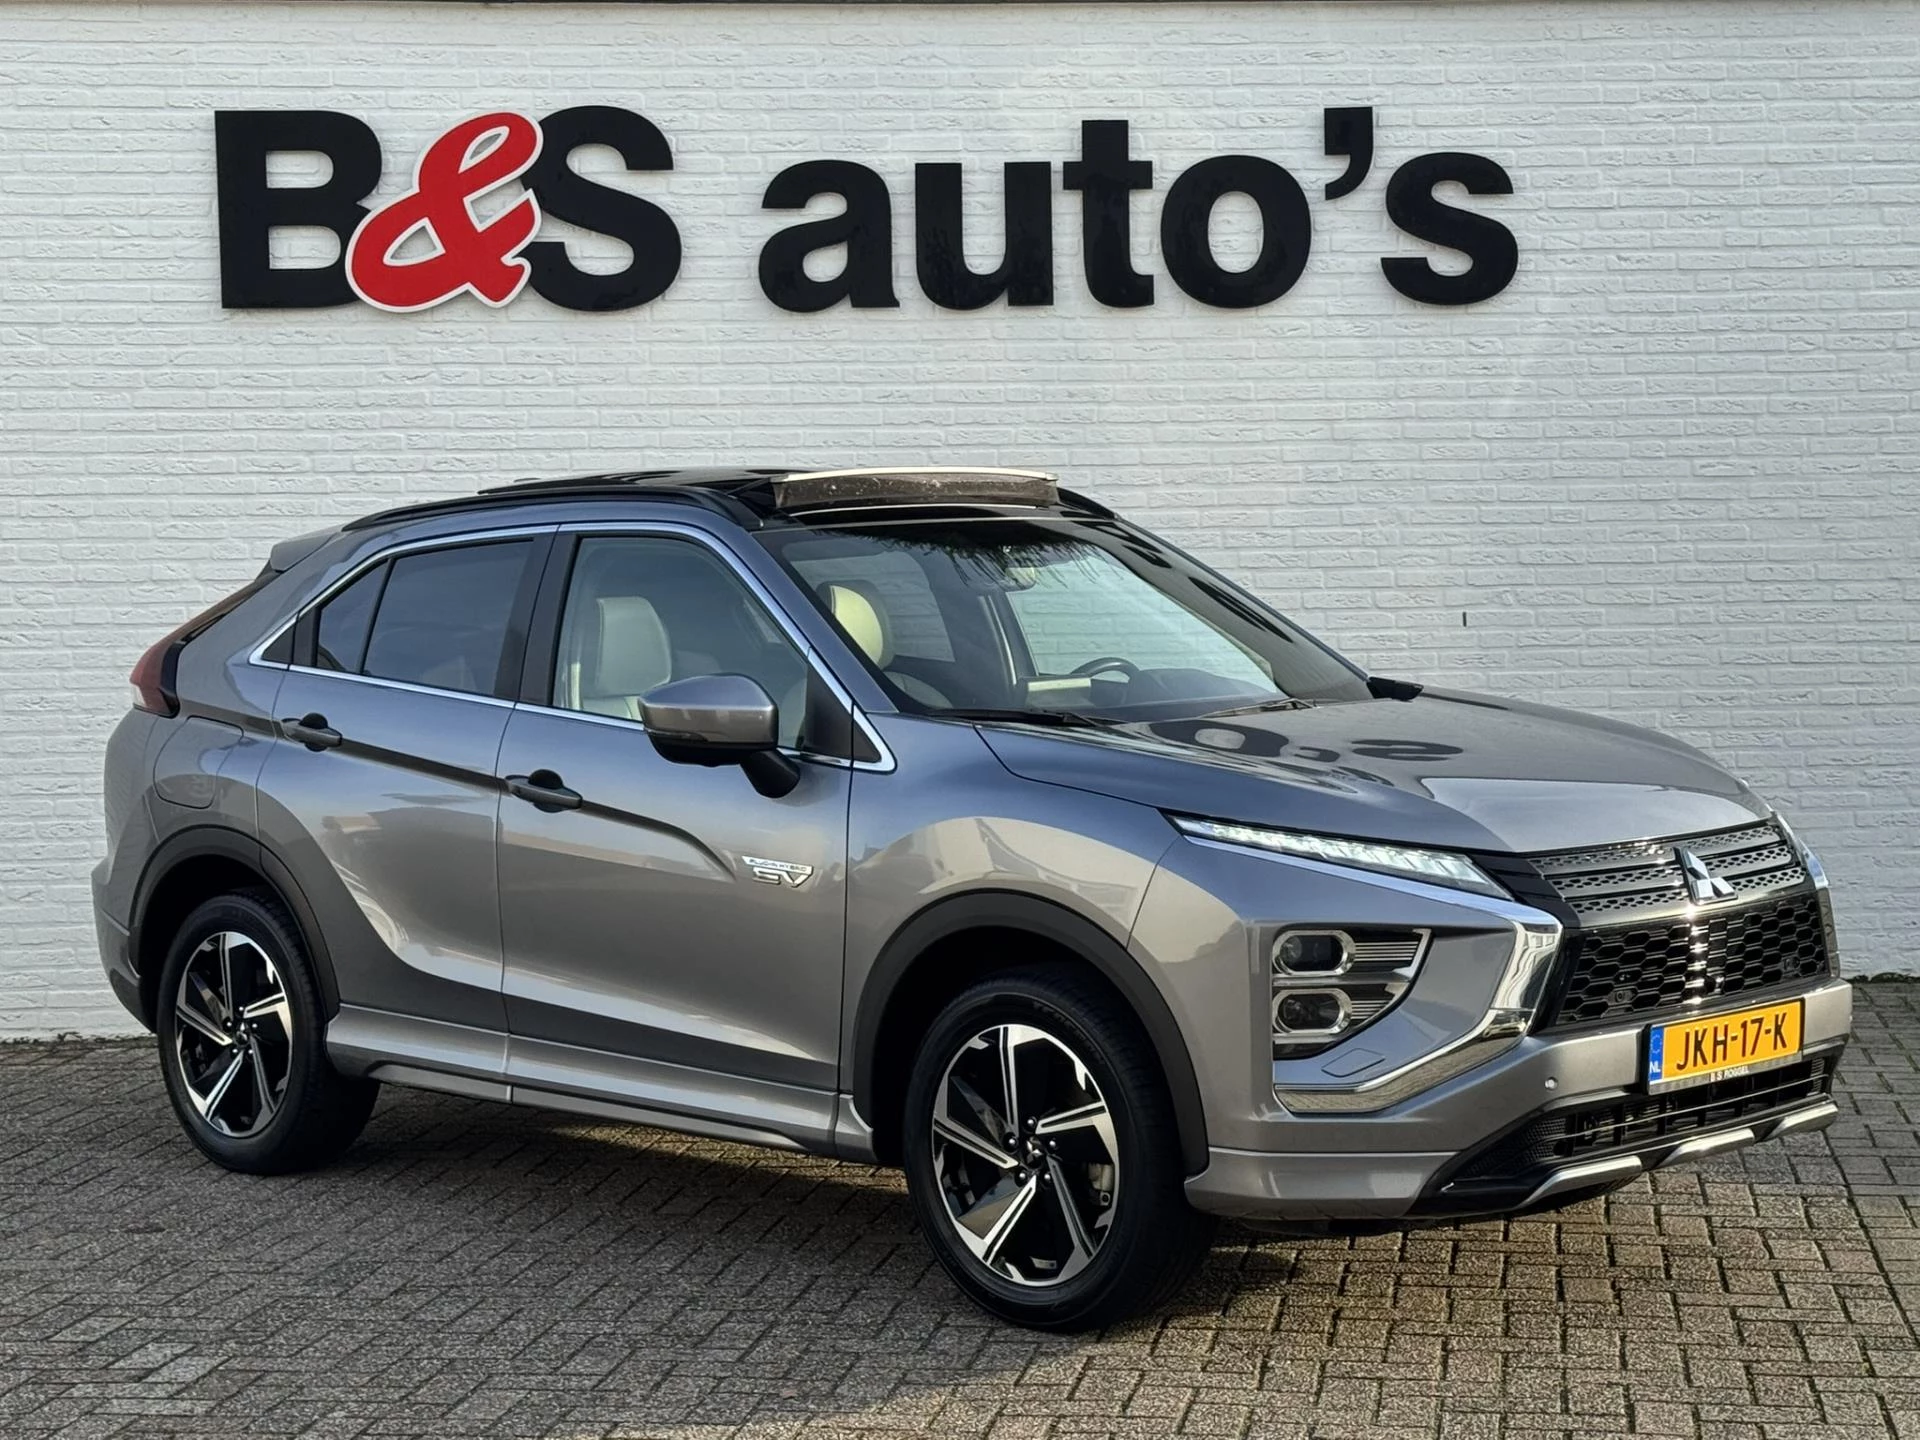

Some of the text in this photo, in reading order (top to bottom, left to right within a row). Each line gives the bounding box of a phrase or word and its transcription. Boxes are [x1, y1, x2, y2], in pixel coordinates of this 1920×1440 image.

[214, 105, 1520, 312] B&S auto's
[1649, 1061, 1662, 1073] NL
[1676, 1012, 1788, 1071] JKH-17-K
